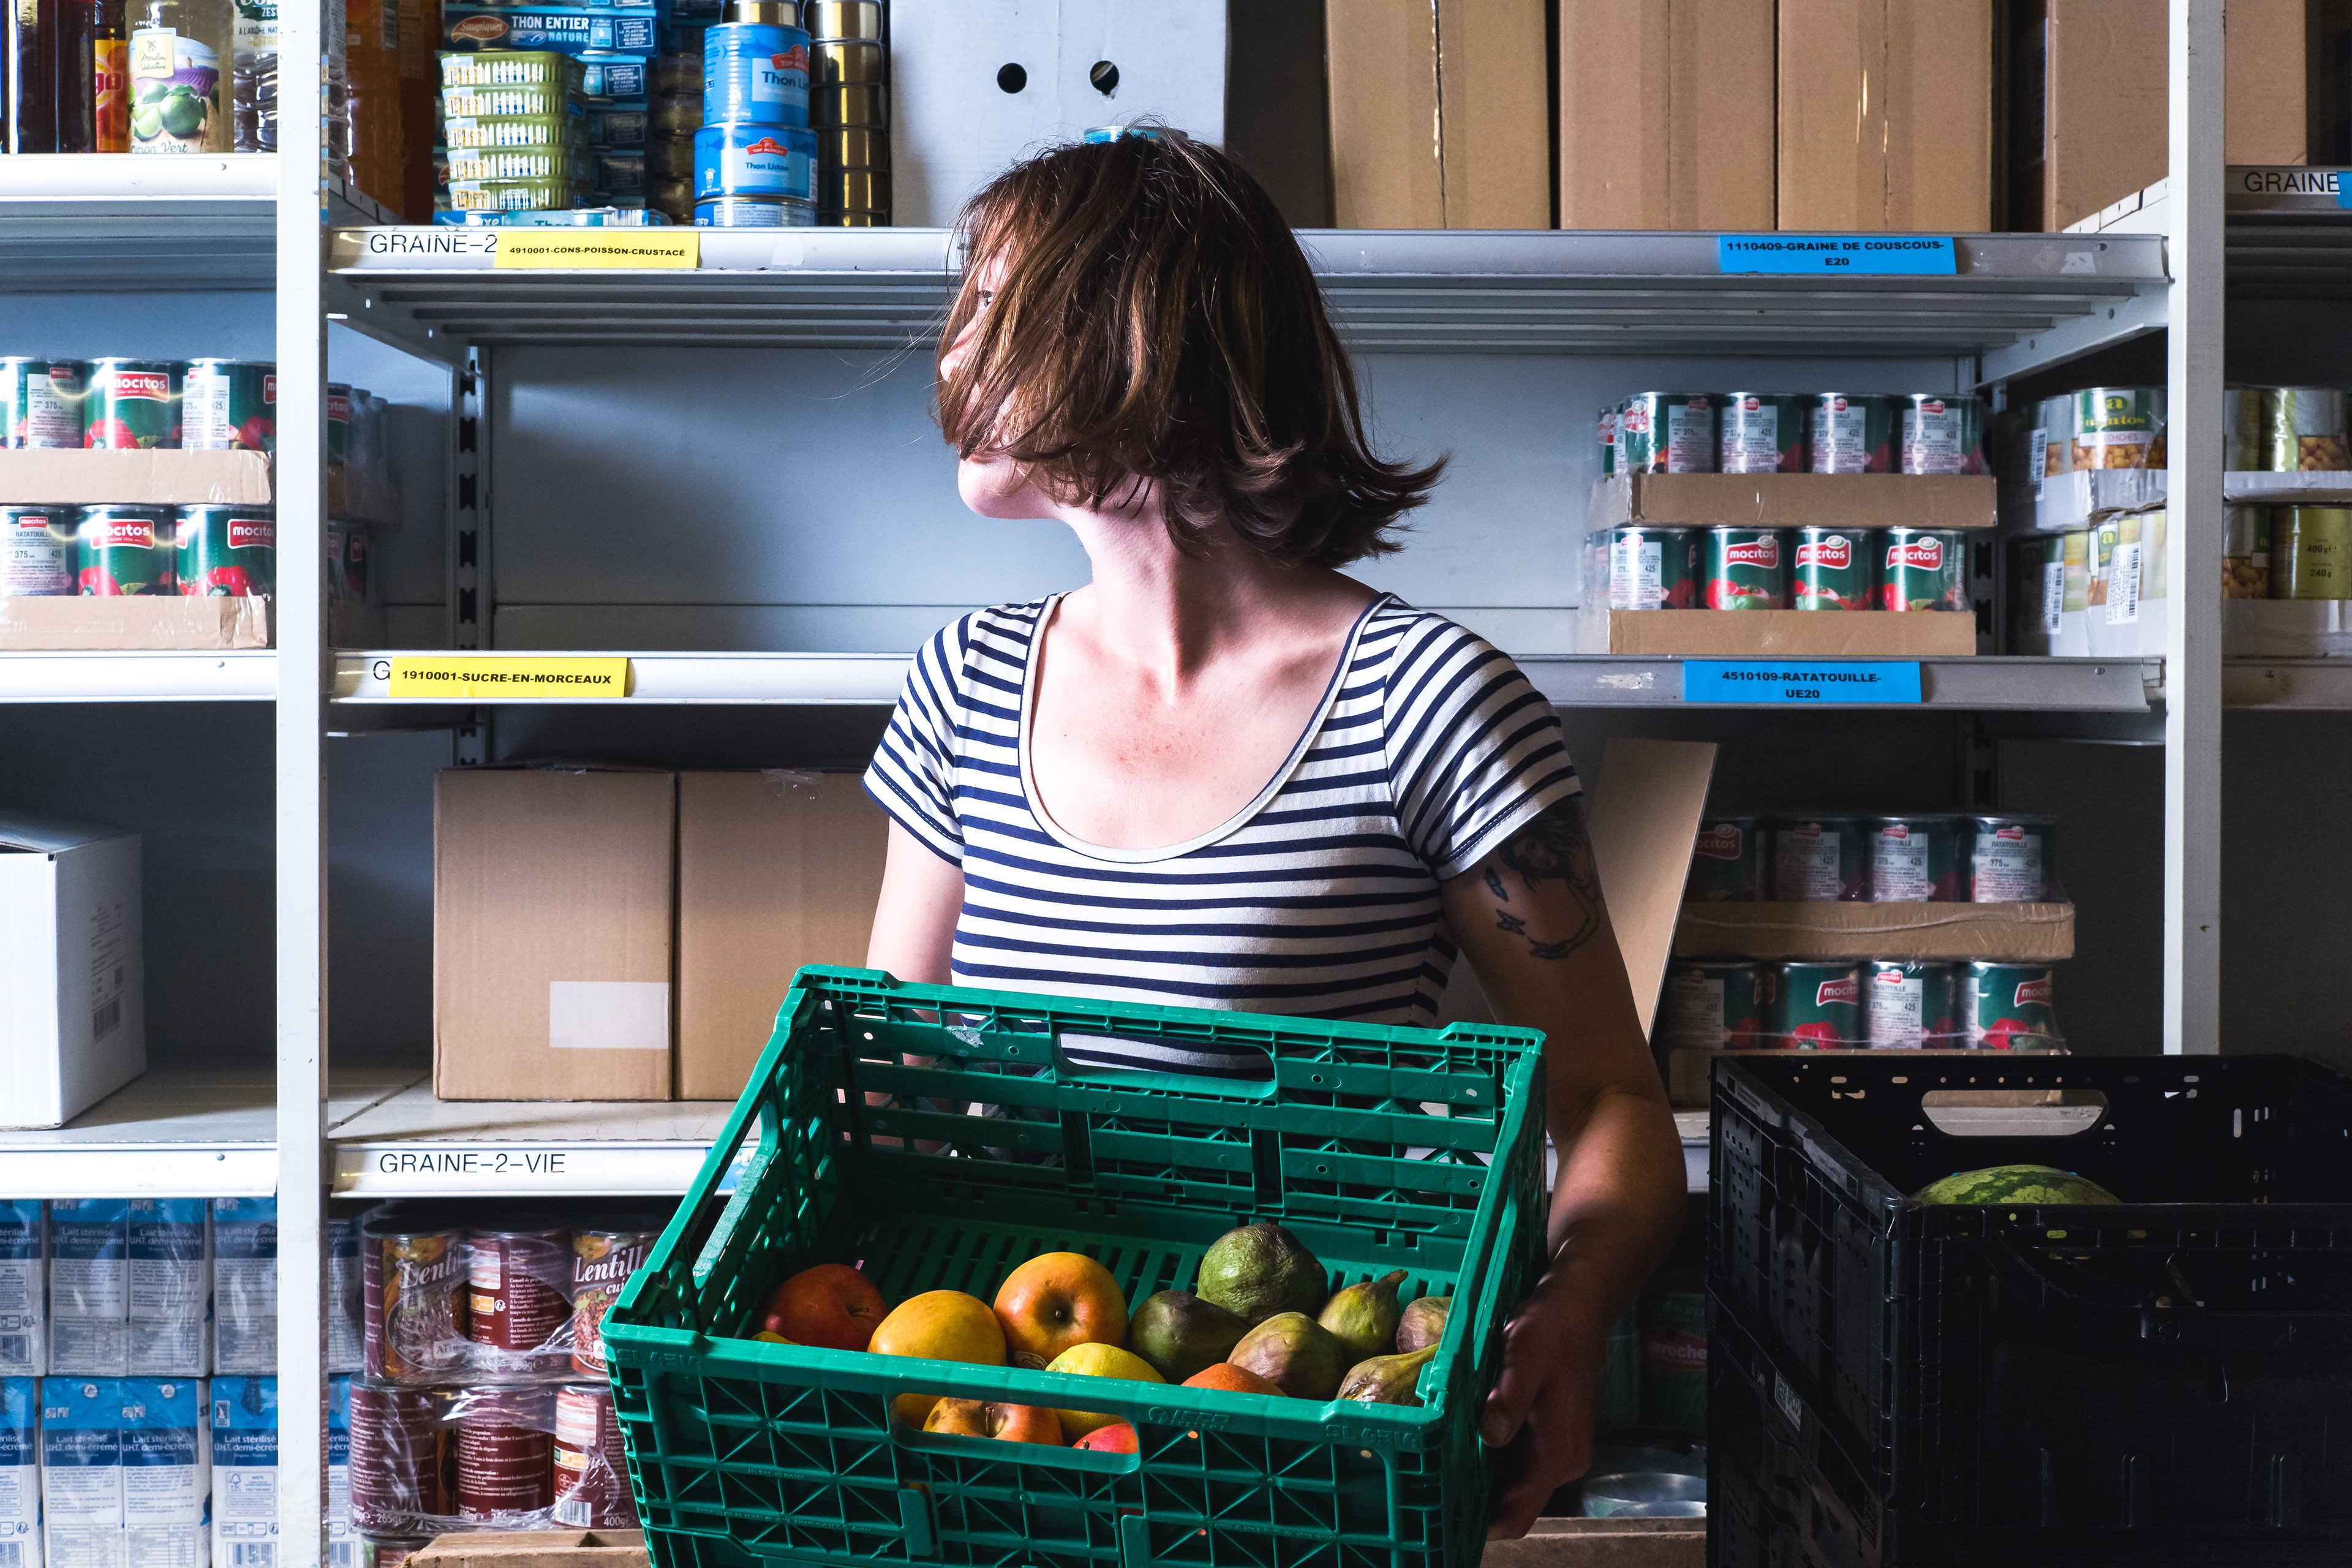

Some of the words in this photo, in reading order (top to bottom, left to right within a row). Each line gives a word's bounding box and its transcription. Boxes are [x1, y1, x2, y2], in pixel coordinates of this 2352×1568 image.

[511, 16, 542, 29] THON
[545, 17, 589, 30] ENTIER
[548, 32, 589, 43] NATURE
[761, 70, 796, 89] Thon
[161, 142, 188, 153] Vert
[767, 162, 790, 172] Listao
[2244, 172, 2341, 192] GRAINE
[1726, 241, 1838, 251] 1110409-GRAINE
[1842, 241, 1861, 251] DE
[1864, 240, 1945, 251] COUSCOUS-
[509, 247, 686, 257] 4910001-CONS-POISSON-CRUSTACÉ
[1825, 257, 1850, 266] E20
[105, 524, 150, 537] ocitos
[1729, 549, 1775, 559] mocitos
[402, 671, 612, 684] 1910001-SUCRE-EN-MORCEAUX
[1721, 671, 1882, 683] 4510109-RATATOUILLE-
[1785, 689, 1821, 699] UE20
[1904, 1002, 1916, 1011] 425
[380, 1153, 566, 1174] GRAINE-2-VIE
[62, 1227, 78, 1236] Lait
[574, 1245, 649, 1283] Lentill
[224, 1434, 241, 1443] Lait
[242, 1434, 276, 1443] stérilisé
[64, 1443, 119, 1452] demi-écrémé
[603, 1517, 625, 1527] 400g
